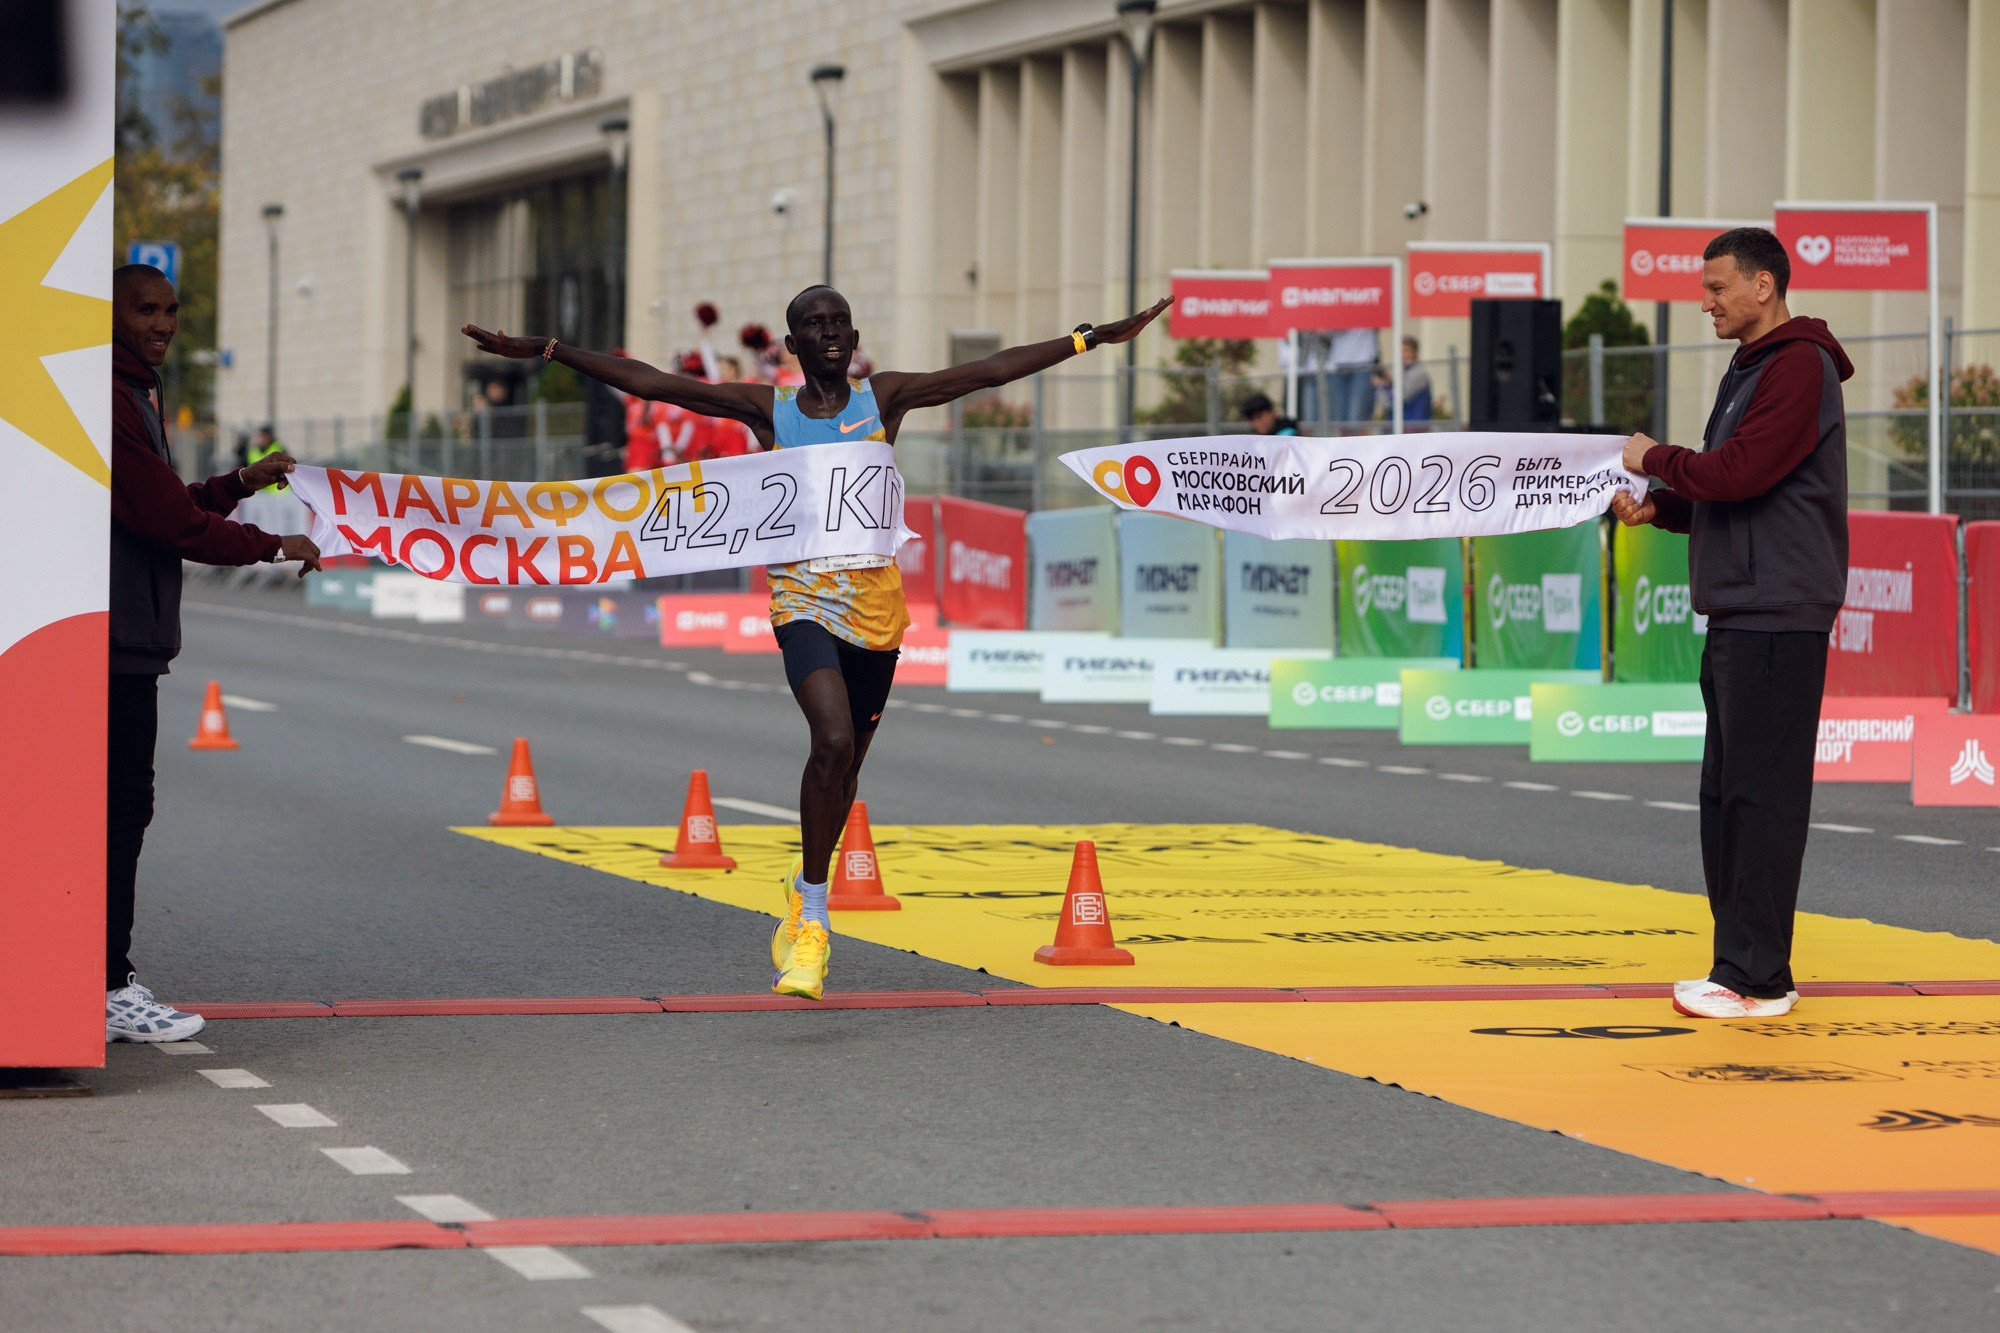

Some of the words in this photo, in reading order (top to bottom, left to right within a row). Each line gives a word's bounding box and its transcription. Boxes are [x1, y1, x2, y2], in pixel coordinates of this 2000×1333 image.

[1167, 451, 1266, 470] СБЕРПРАЙМ
[1515, 457, 1562, 472] БЫТЬ
[1172, 470, 1305, 496] МОСКОВСКИЙ
[1320, 455, 1501, 515] 2026
[325, 461, 706, 529] МАРАФОН
[640, 473, 798, 554] 42,2
[1177, 492, 1262, 515] МАРАФОН
[1515, 492, 1552, 509] ДЛЯ
[336, 524, 647, 586] МОСКВА
[1320, 685, 1375, 703] СБЕР
[1455, 699, 1512, 717] СБЕР
[1588, 715, 1648, 733] СБЕР
